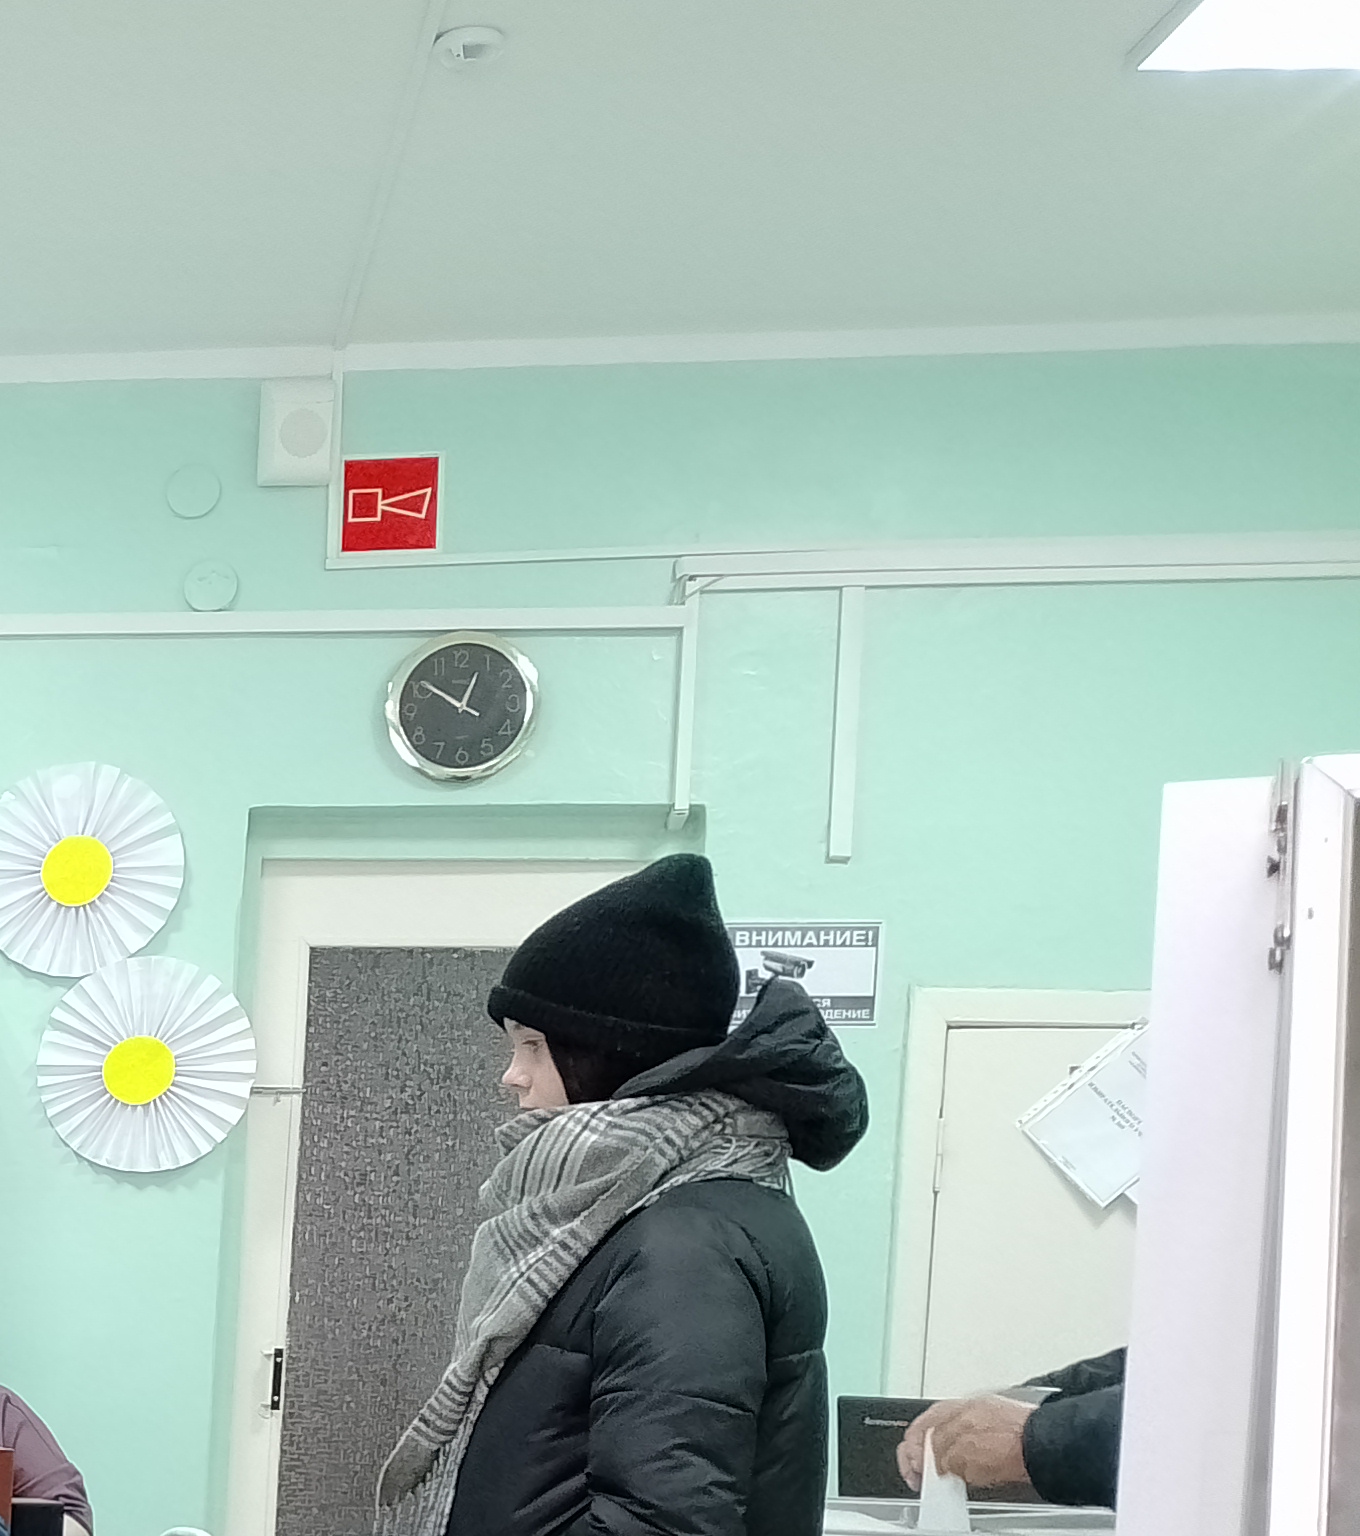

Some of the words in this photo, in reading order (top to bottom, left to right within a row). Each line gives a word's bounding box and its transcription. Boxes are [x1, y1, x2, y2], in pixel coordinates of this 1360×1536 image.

[433, 657, 445, 676] 11
[453, 650, 469, 668] 12
[484, 654, 491, 671] 1
[499, 669, 513, 688] 2
[402, 703, 417, 721] 9
[505, 694, 520, 712] 3
[412, 726, 426, 745] 8
[497, 719, 513, 738] 4
[432, 741, 446, 759] 7
[455, 747, 469, 765] 6
[480, 738, 494, 757] 5
[734, 930, 873, 946] ВНИМАНИЕ!
